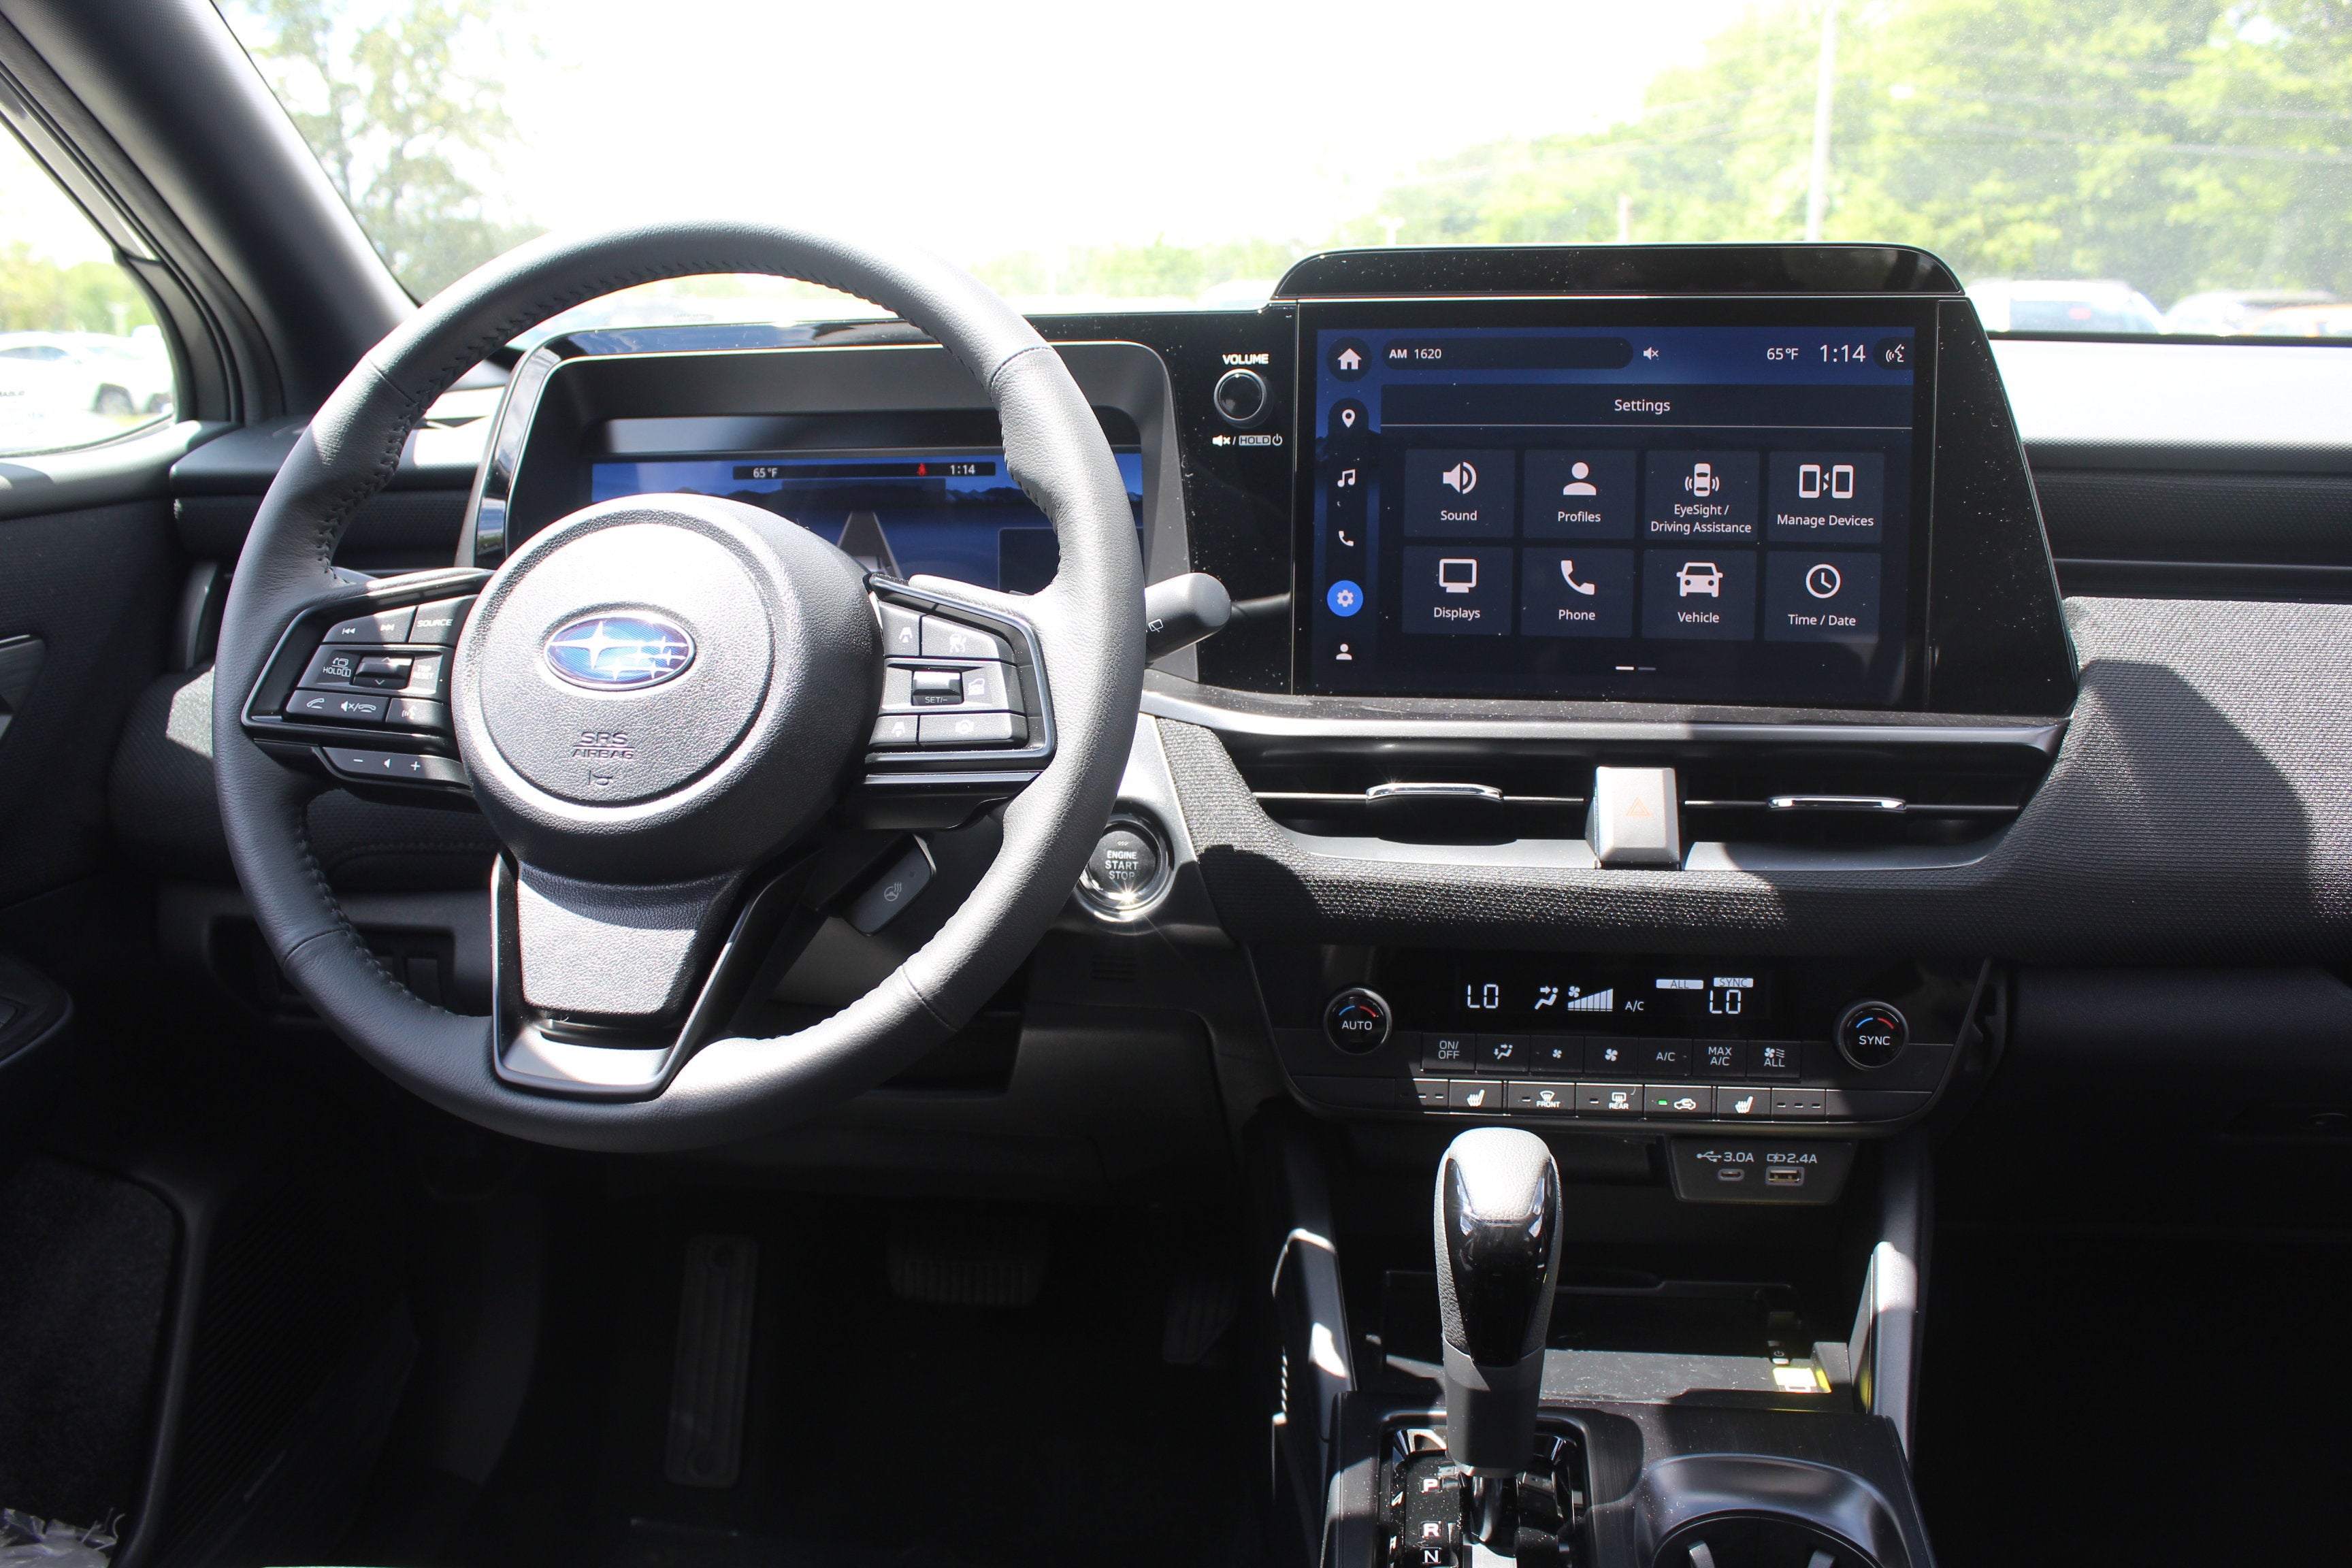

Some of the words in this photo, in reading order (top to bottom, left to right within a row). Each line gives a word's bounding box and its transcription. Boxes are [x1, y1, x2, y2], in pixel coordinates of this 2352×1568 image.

[1389, 349, 1407, 358] AM
[1415, 348, 1441, 359] 1620
[1820, 345, 1865, 362] 1:14
[1222, 354, 1269, 365] VOLUME
[1615, 399, 1670, 414] Settings
[1240, 436, 1270, 444] HOLD
[951, 465, 975, 474] 1:14
[1441, 510, 1477, 521] Sound
[1558, 511, 1601, 522] Profiles
[1674, 504, 1722, 518] EyeSight
[1777, 514, 1825, 529] Manage
[1829, 515, 1874, 527] Devices
[1650, 521, 1690, 536] Driving
[1693, 522, 1752, 533] Assistance
[1434, 607, 1480, 621] Displays
[1559, 610, 1595, 620] Phone
[1678, 612, 1719, 623] Vehicle
[417, 619, 454, 627] SOURCE
[1788, 615, 1817, 625] Time
[1829, 615, 1856, 626] Date
[323, 667, 342, 676] HOLD
[580, 731, 629, 746] SRS
[572, 748, 635, 760] AIRBAG
[1107, 851, 1137, 860] ENGINE
[1105, 860, 1139, 870] START
[1109, 870, 1135, 881] STOP
[1670, 979, 1689, 989] ALL
[1719, 977, 1748, 987] SYNC
[1625, 1000, 1644, 1012] A/C
[1342, 1021, 1372, 1030] AUTO
[1859, 1036, 1890, 1045] SYNC
[1438, 1050, 1460, 1059] OFF
[1656, 1052, 1675, 1061] A/C
[1709, 1047, 1731, 1056] MAX
[1710, 1057, 1729, 1066] A/C
[1764, 1058, 1785, 1067] ALL
[1724, 1152, 1754, 1162] 3.0A
[1787, 1154, 1817, 1163] 2.4A
[1423, 1478, 1439, 1492] P
[1423, 1523, 1441, 1537] R
[1424, 1550, 1439, 1563] N
